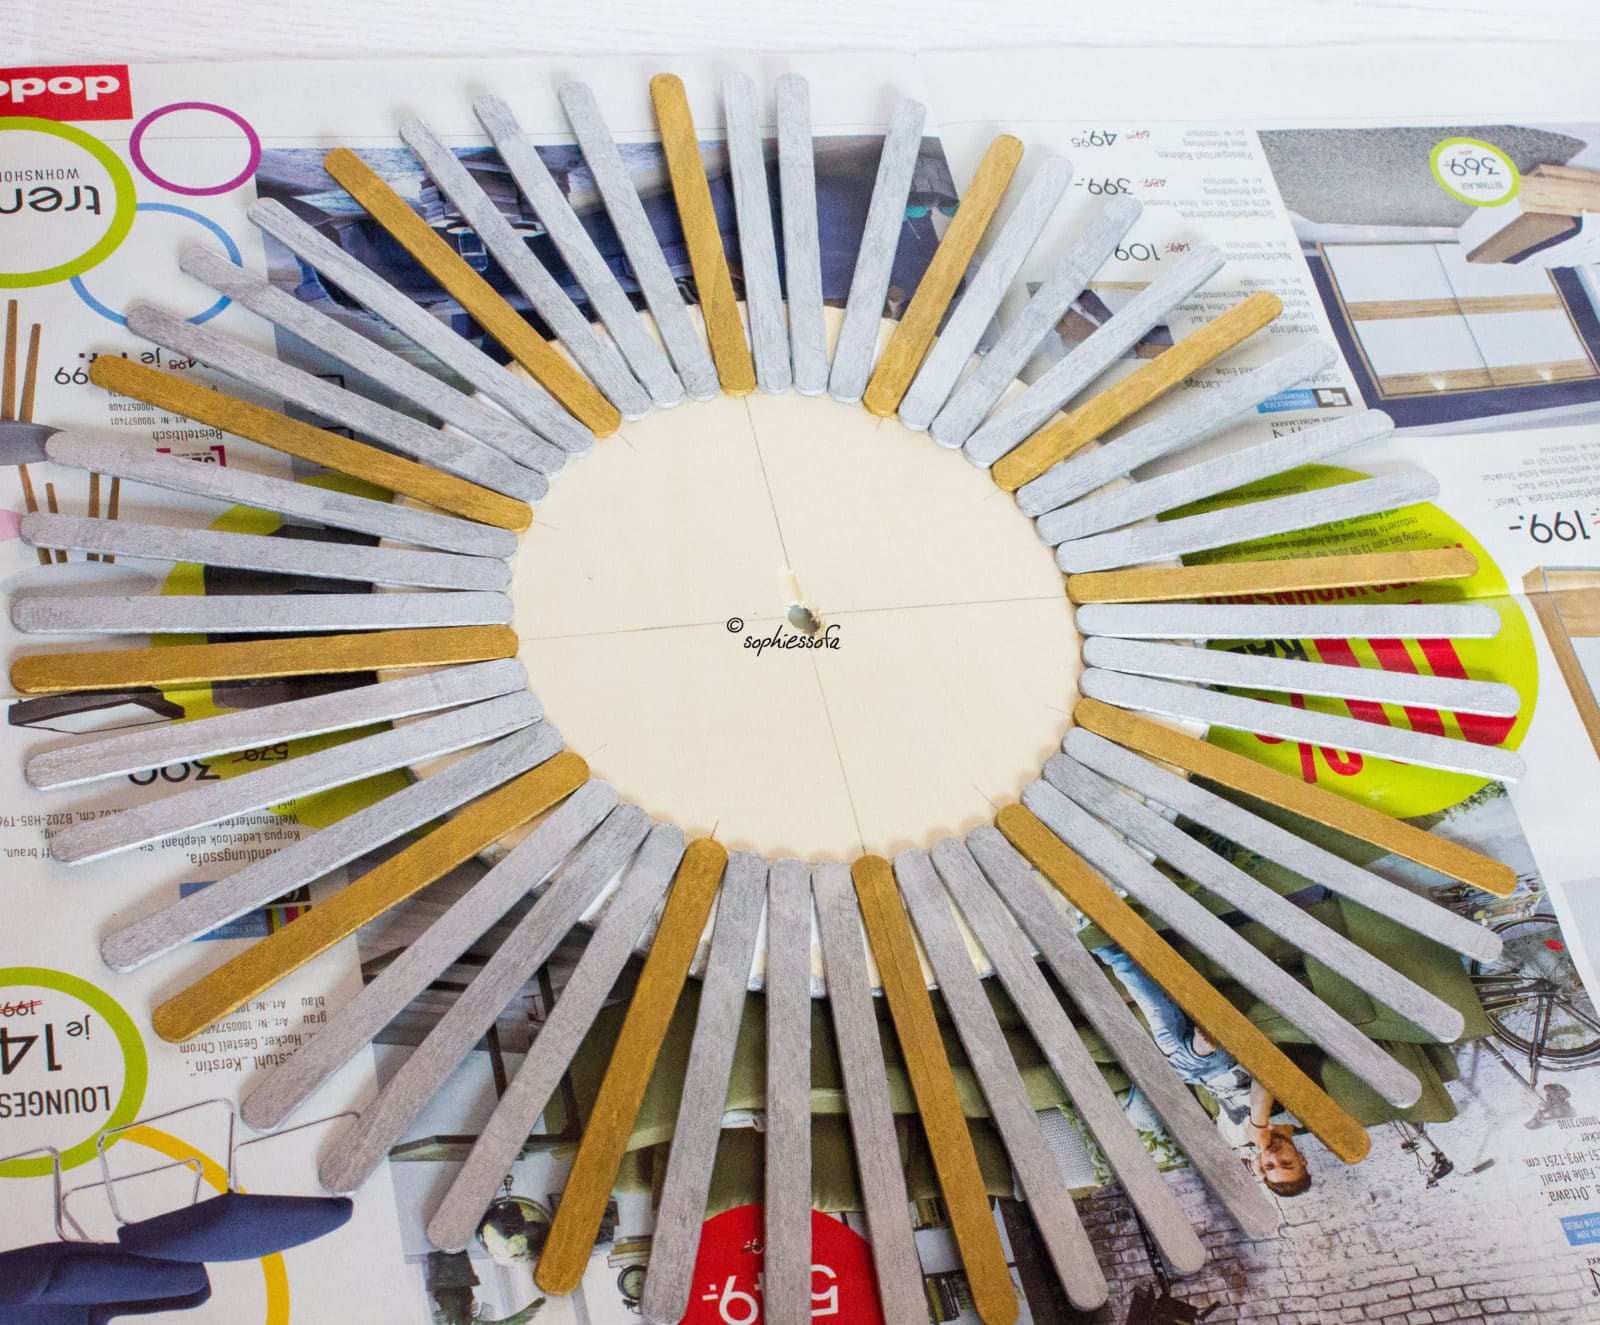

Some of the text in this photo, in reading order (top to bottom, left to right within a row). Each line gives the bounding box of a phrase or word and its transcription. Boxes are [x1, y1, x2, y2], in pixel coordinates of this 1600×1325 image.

[0, 167, 80, 185] WOHNSHO
[141, 348, 162, 368] je
[152, 429, 223, 443] Beistelltisch
[1509, 510, 1591, 544] 199.-
[210, 832, 262, 847] Lederlook
[264, 830, 301, 843] Korpus
[187, 848, 276, 868] andlungssofa,
[301, 996, 325, 1008] blau
[303, 1011, 328, 1026] grau
[66, 1014, 91, 1041] je
[218, 1038, 259, 1052] Gestell
[260, 1033, 303, 1047] Hocker,
[179, 1041, 216, 1056] Chrom
[701, 1263, 839, 1325] 59.-
